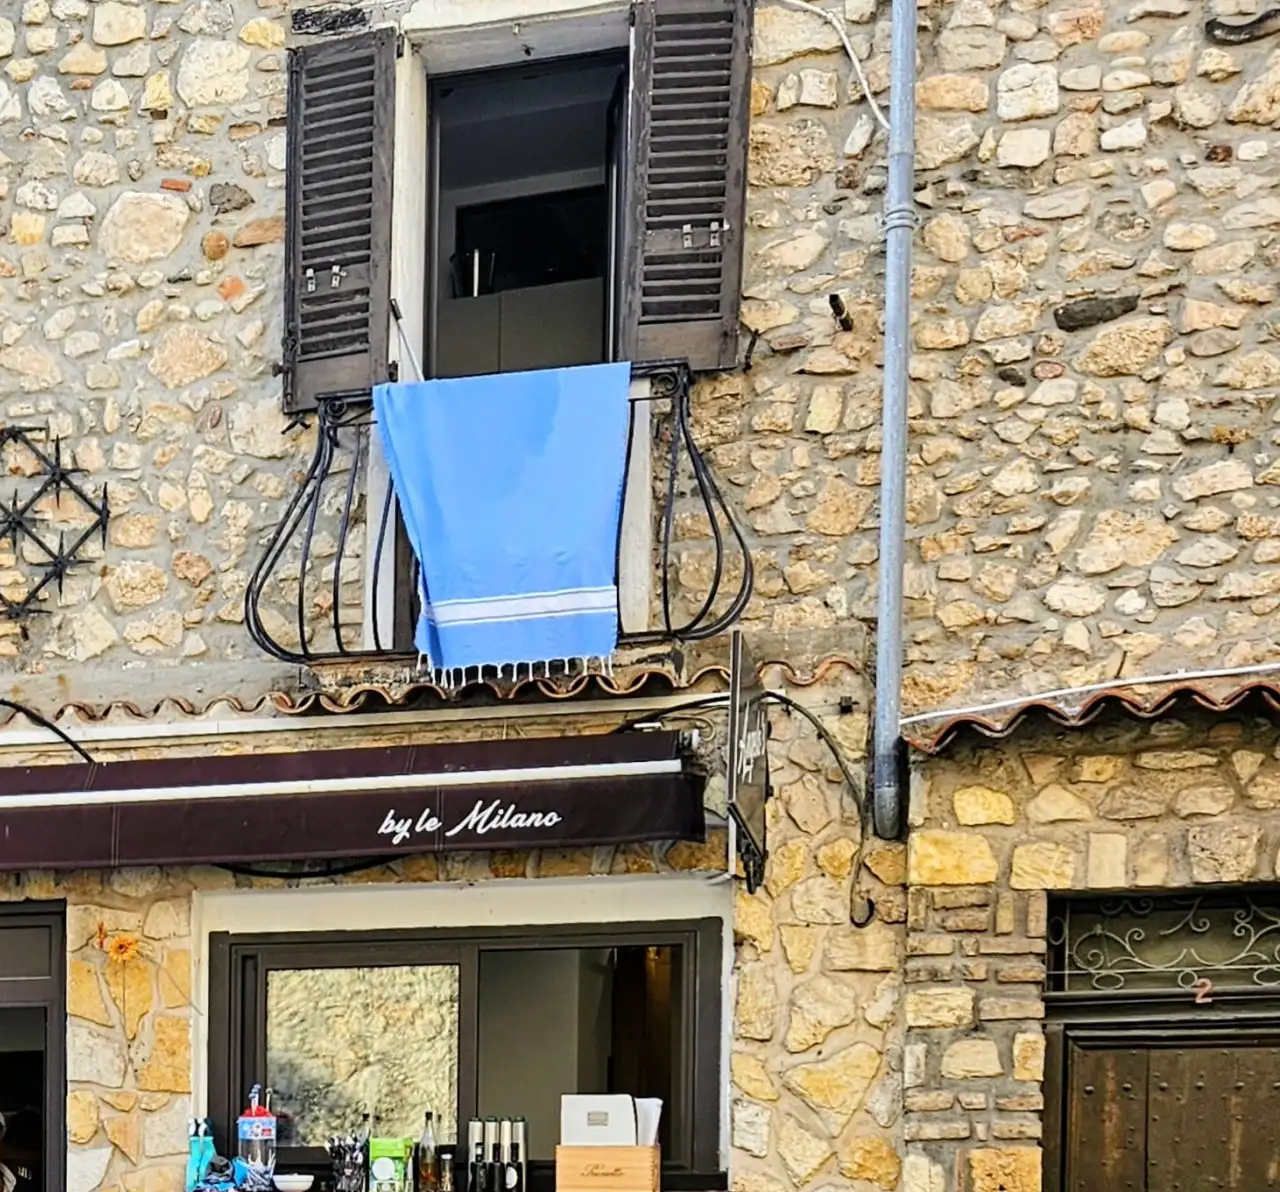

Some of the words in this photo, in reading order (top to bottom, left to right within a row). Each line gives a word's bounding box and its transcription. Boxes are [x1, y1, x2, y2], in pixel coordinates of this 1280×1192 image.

[377, 808, 412, 845] by
[414, 807, 442, 833] le
[445, 799, 562, 838] Milano
[1194, 977, 1213, 1004] 2
